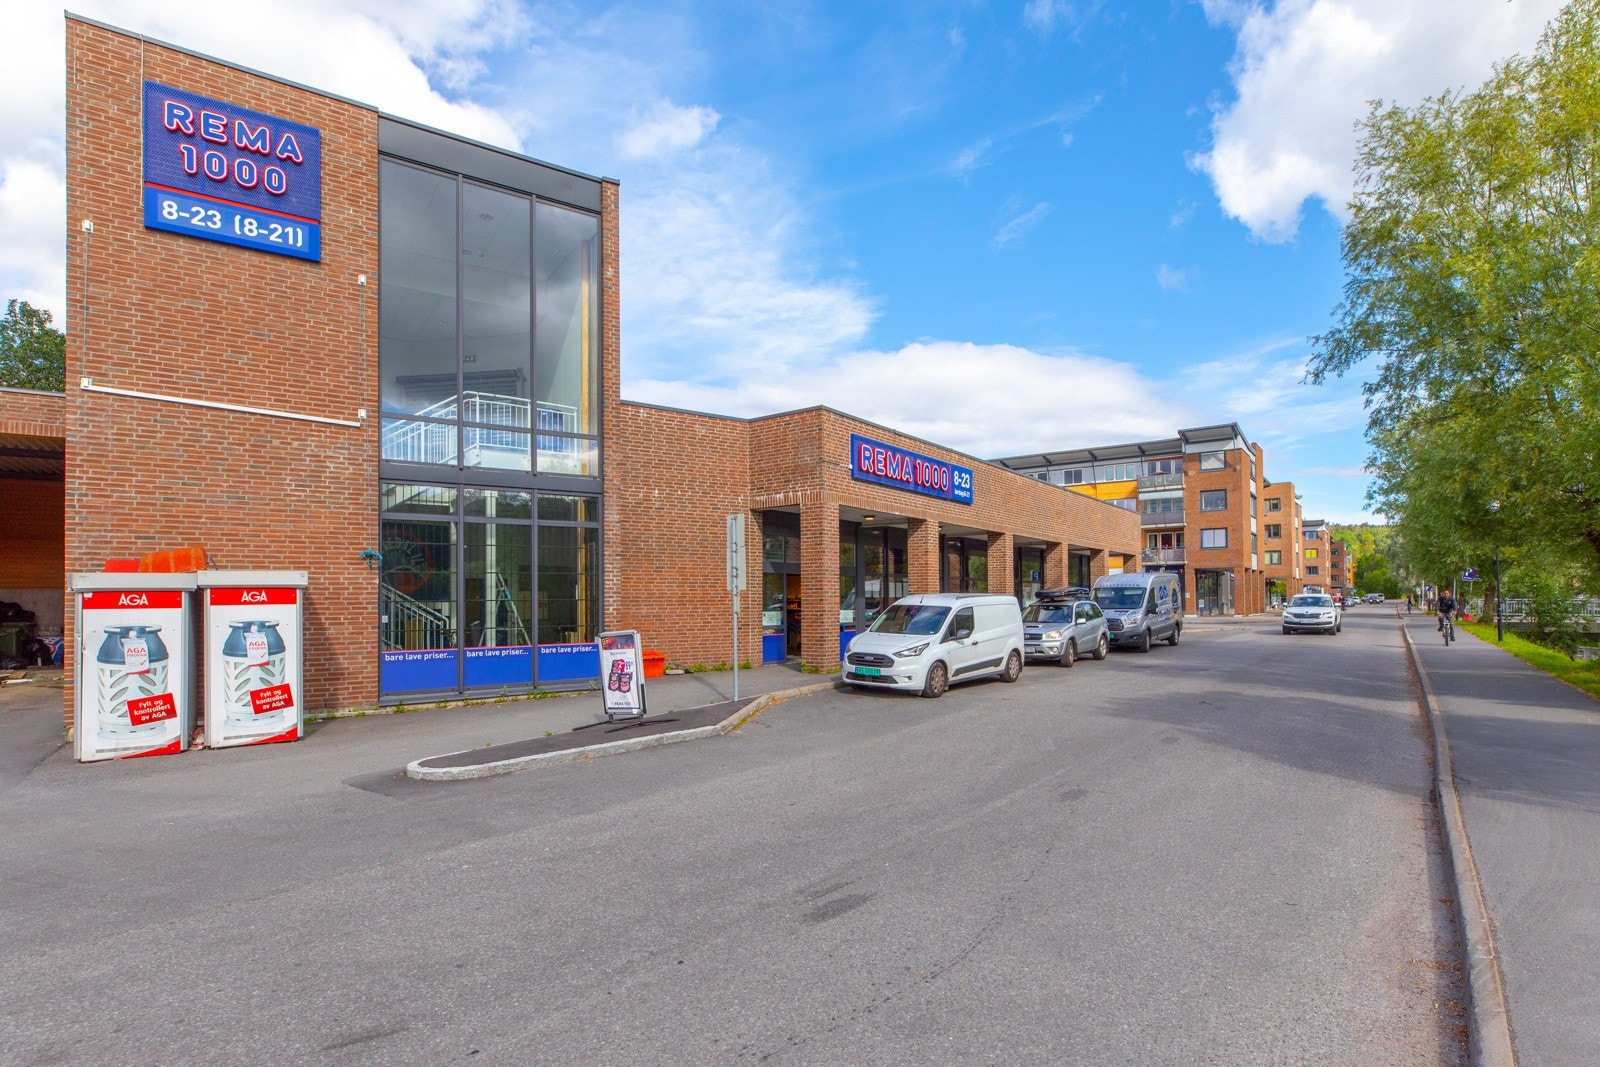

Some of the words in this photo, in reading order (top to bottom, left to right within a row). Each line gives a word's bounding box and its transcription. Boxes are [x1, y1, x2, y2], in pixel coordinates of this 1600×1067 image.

[164, 100, 303, 163] REMA
[179, 143, 288, 196] 1000
[161, 200, 222, 230] 8-23
[233, 214, 304, 248] (8-21)
[860, 444, 912, 482] REMA
[915, 460, 949, 491] 1000
[953, 470, 971, 489] 8-23
[118, 593, 149, 606] AGA
[241, 590, 268, 603] AGA
[466, 650, 484, 658] bare
[485, 649, 500, 657] lave
[138, 700, 152, 708] Fylt
[255, 693, 288, 705] kontrollert
[271, 700, 285, 708] AGA
[133, 703, 171, 716] kontrollert
[151, 711, 167, 719] AGA
